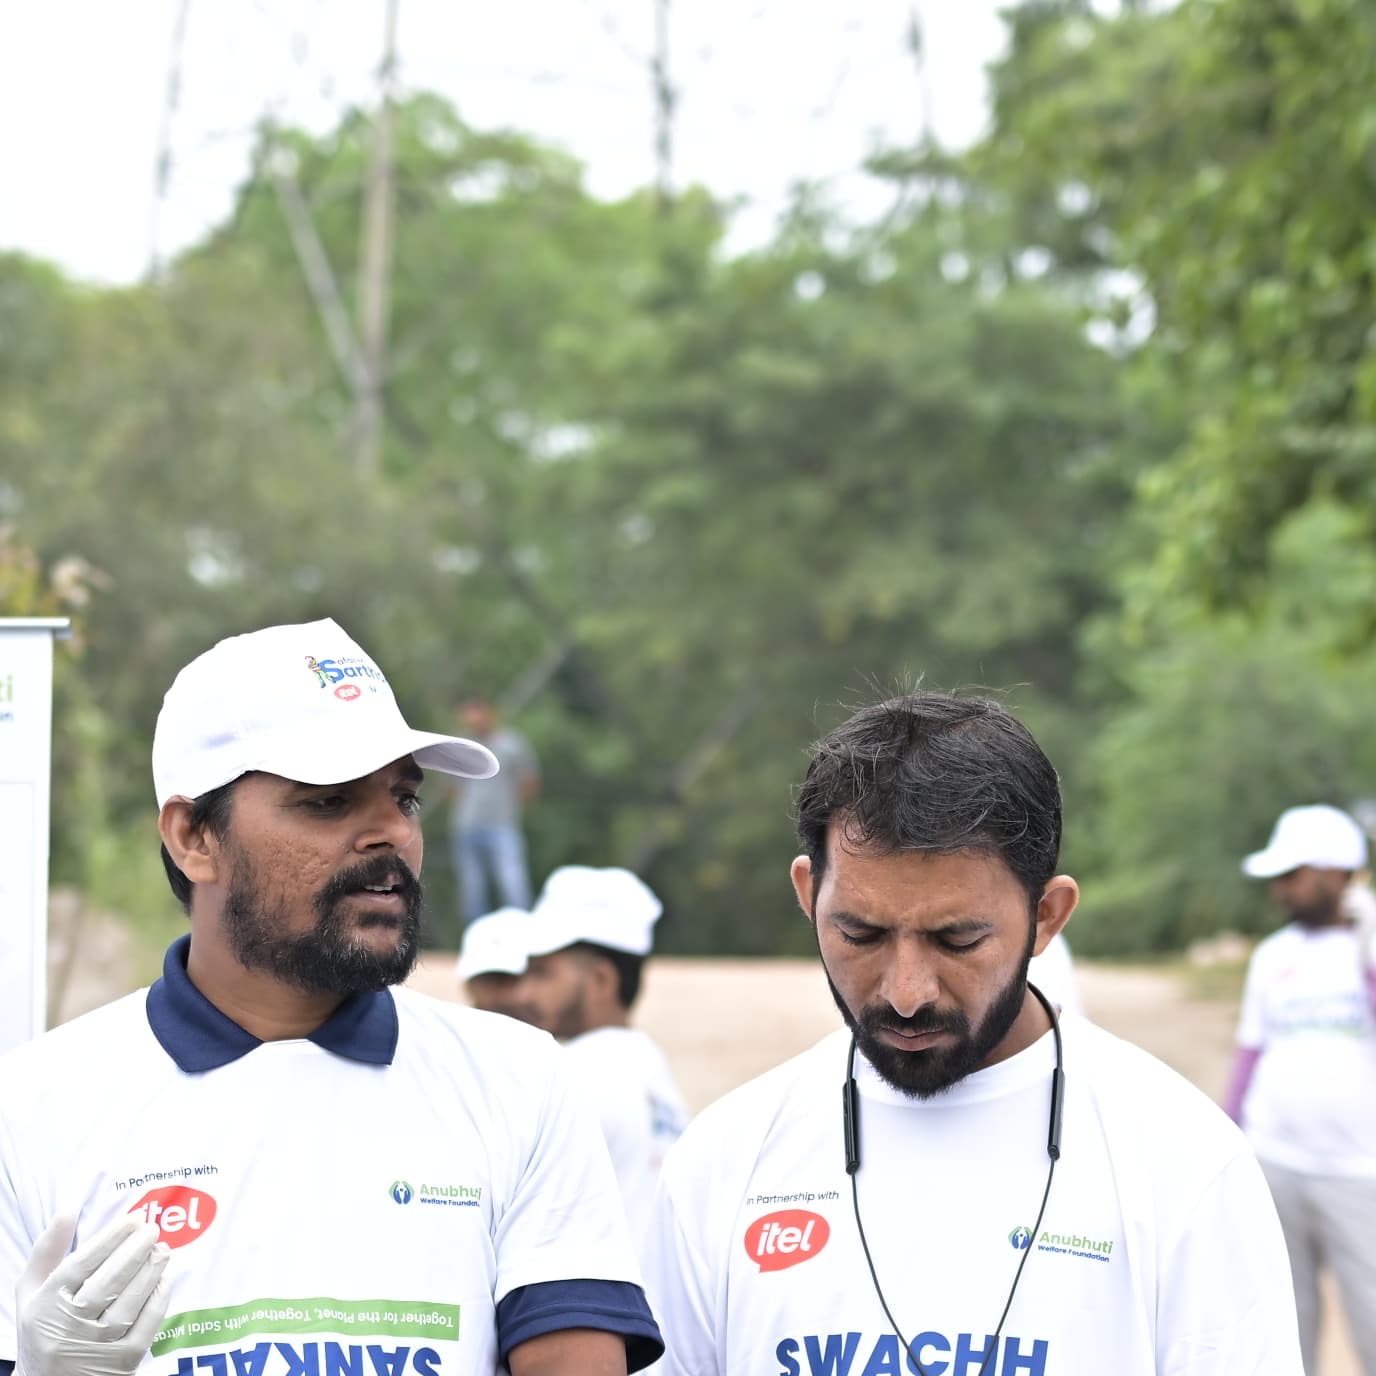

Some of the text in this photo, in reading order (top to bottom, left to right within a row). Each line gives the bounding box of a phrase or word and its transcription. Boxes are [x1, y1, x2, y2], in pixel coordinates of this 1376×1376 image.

[115, 1181, 126, 1191] In
[194, 1164, 219, 1176] with
[756, 1191, 815, 1204] Partnership
[817, 1190, 840, 1201] with
[143, 1196, 201, 1233] tel
[756, 1219, 816, 1257] itel
[1039, 1231, 1113, 1255] Anubhuti
[1037, 1243, 1110, 1263] Welfare Foundation
[224, 1315, 250, 1330] with
[250, 1307, 312, 1322] Together
[314, 1307, 355, 1324] Planet,
[357, 1311, 381, 1323] the
[382, 1312, 399, 1325] for
[400, 1311, 454, 1328] Together
[188, 1320, 221, 1333] Safai
